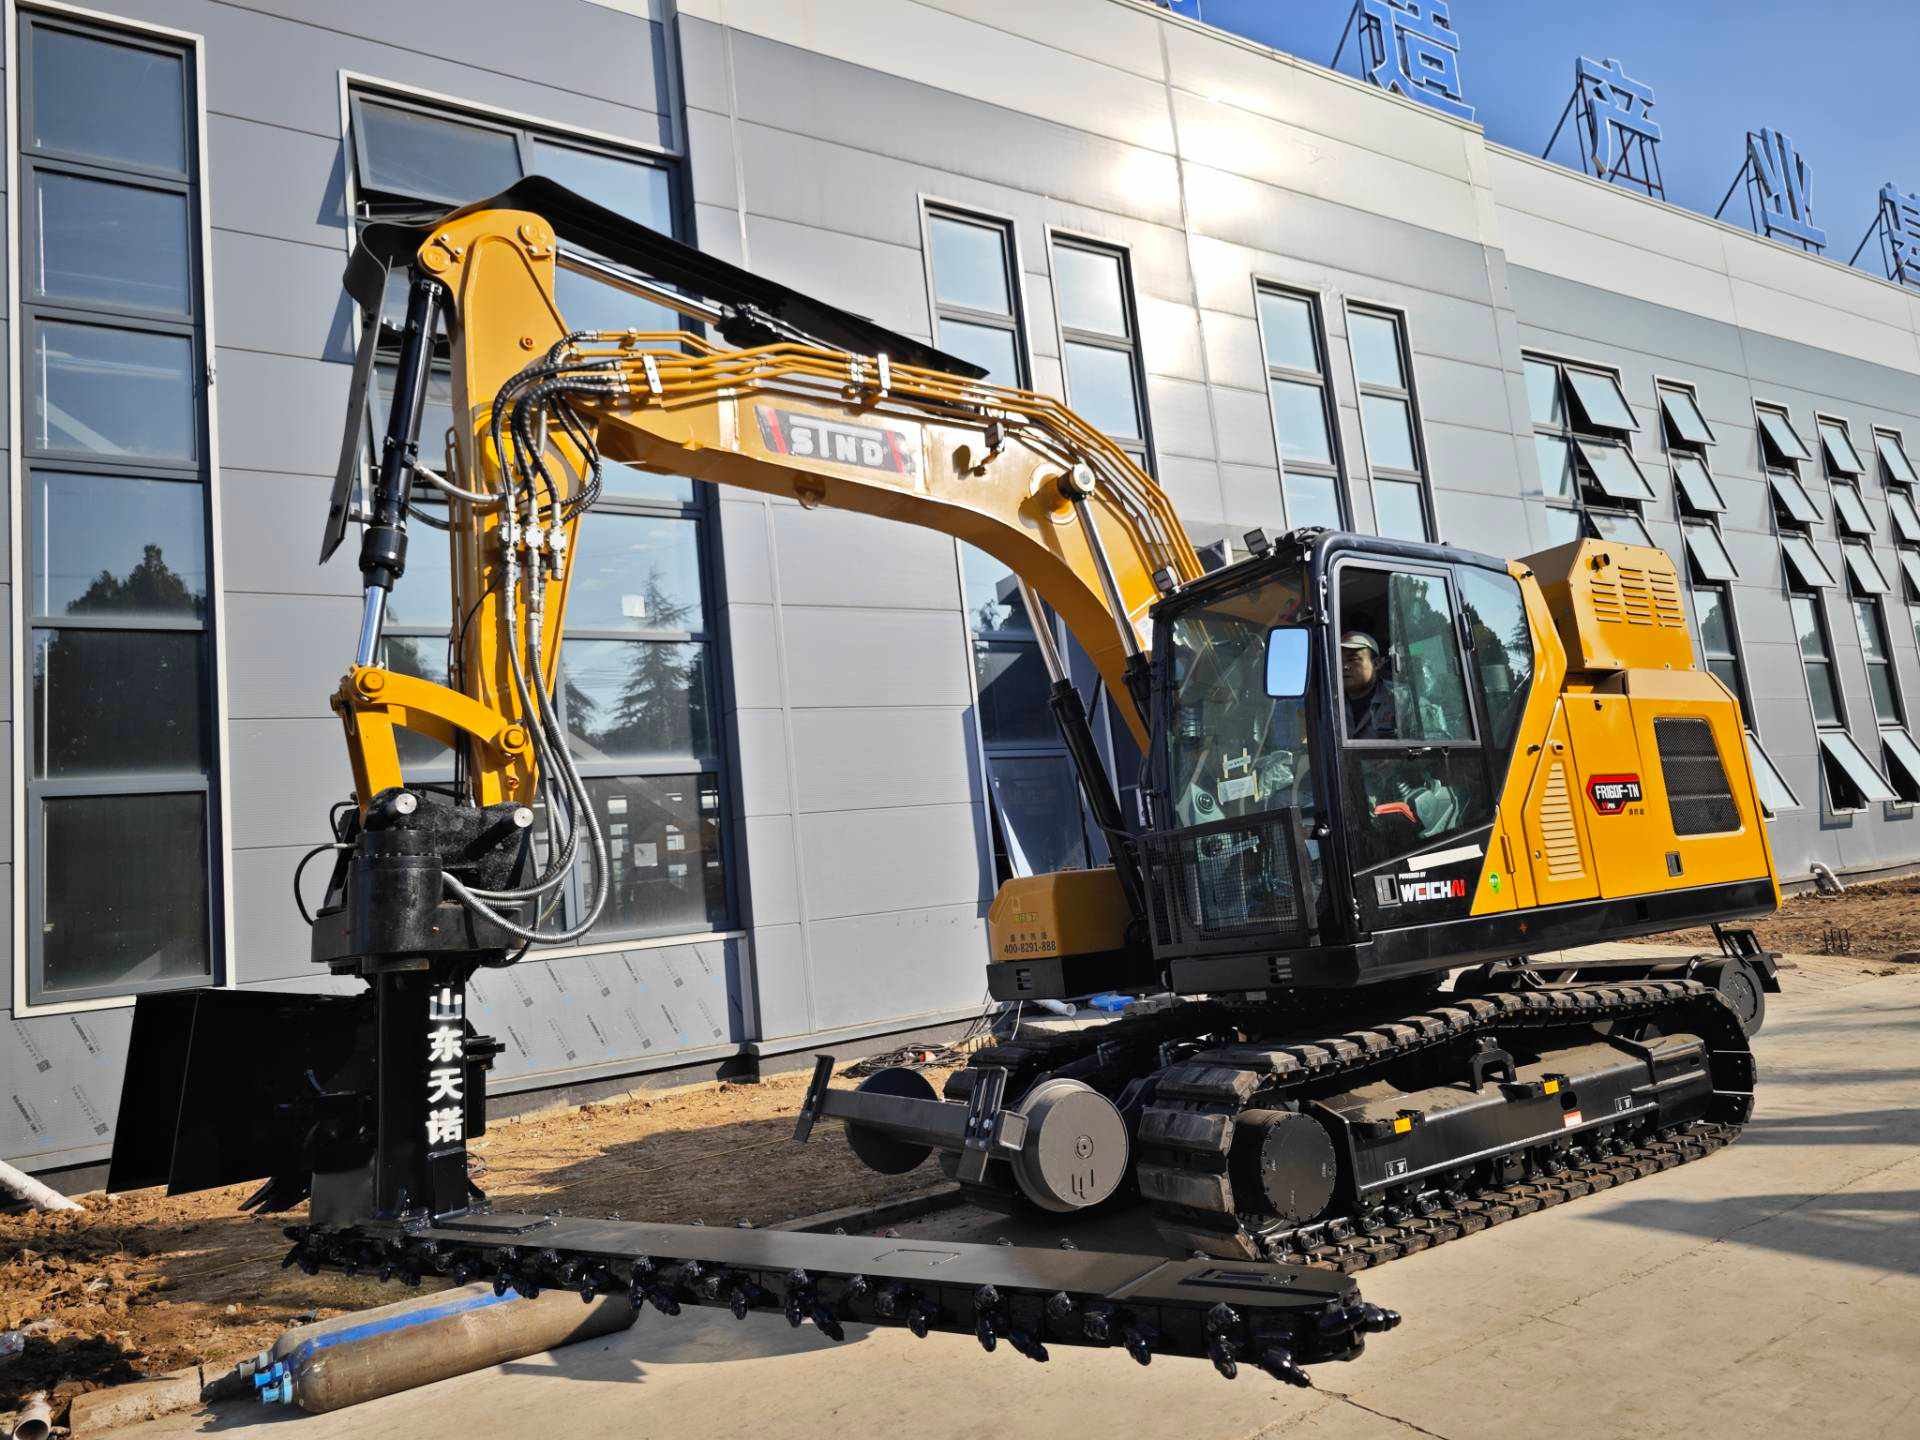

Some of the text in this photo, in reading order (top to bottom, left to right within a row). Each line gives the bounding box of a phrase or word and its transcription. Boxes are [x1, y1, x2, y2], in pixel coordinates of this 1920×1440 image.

[1400, 879, 1466, 902] WEICHAI
[425, 987, 465, 1145] 山东天诺
